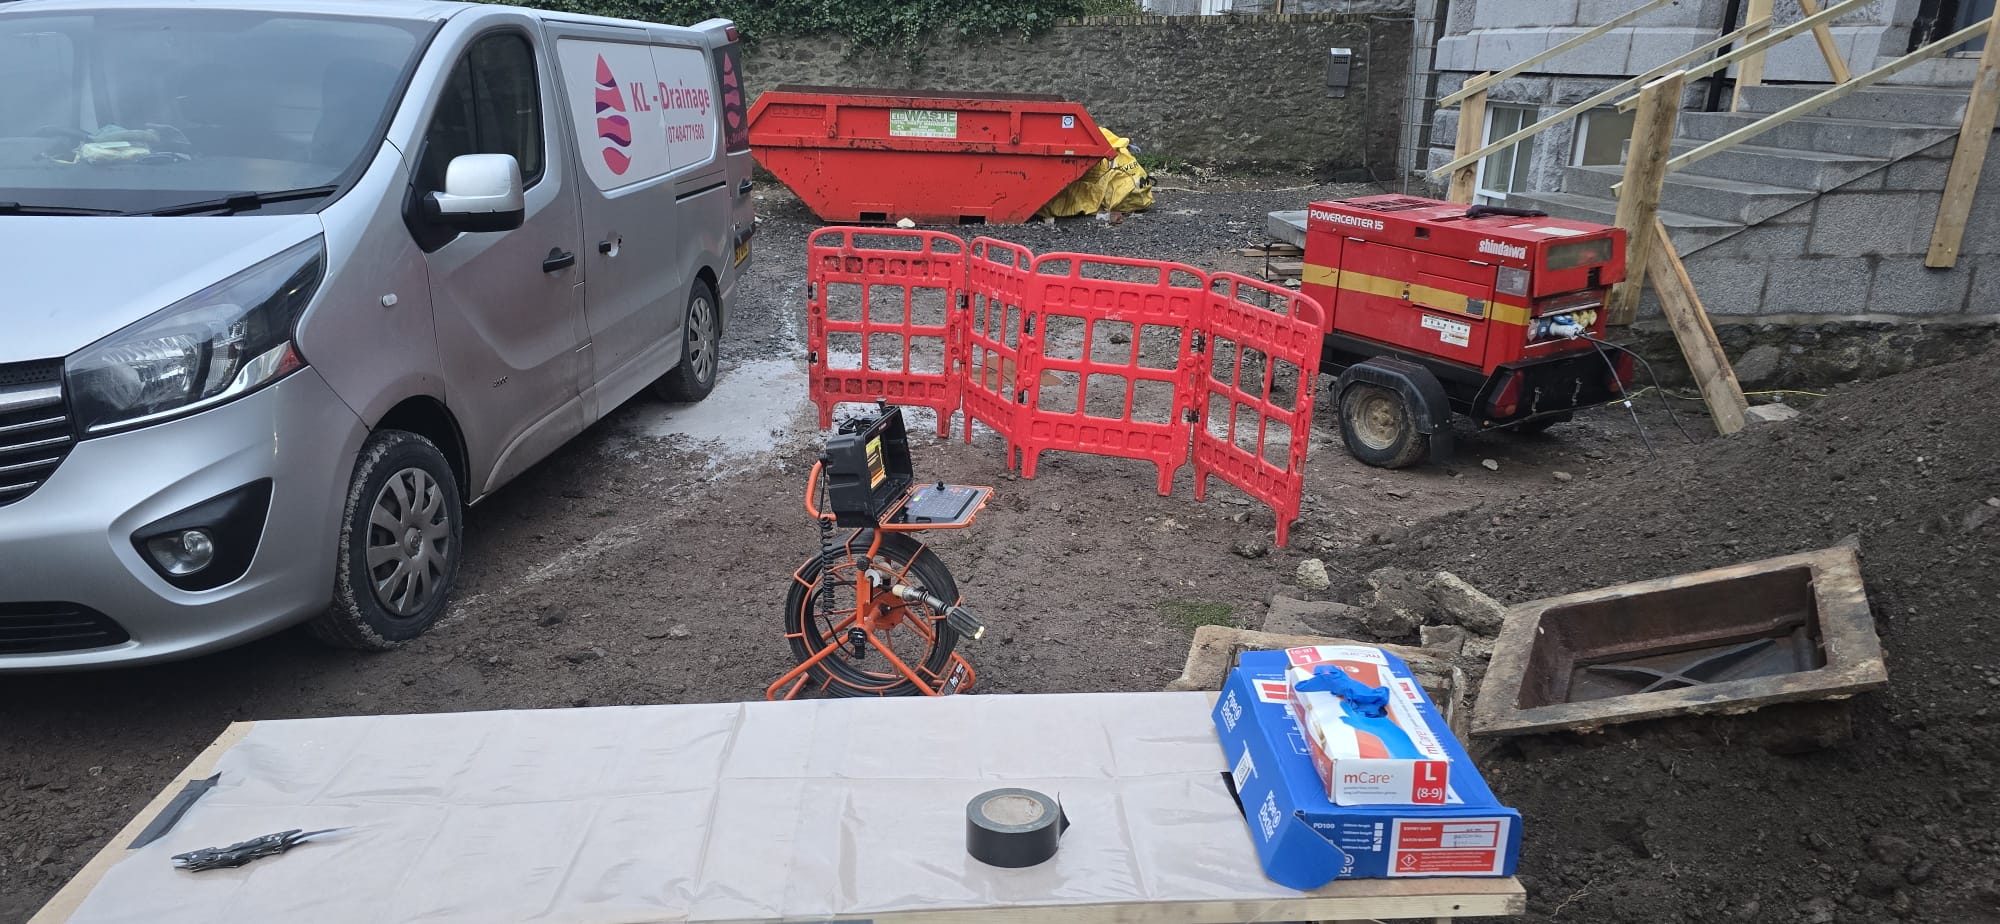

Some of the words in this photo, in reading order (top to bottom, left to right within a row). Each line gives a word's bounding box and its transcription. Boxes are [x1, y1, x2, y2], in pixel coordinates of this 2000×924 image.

[630, 82, 651, 112] KL
[659, 79, 710, 116] Drainage
[905, 110, 956, 122] WASTE
[1310, 209, 1374, 228] POWERCENTER
[1374, 220, 1384, 230] 15
[1479, 238, 1526, 260] shindaiwa
[1344, 771, 1390, 784] mCare
[1425, 762, 1437, 781] L
[1416, 787, 1443, 800] (8-9)
